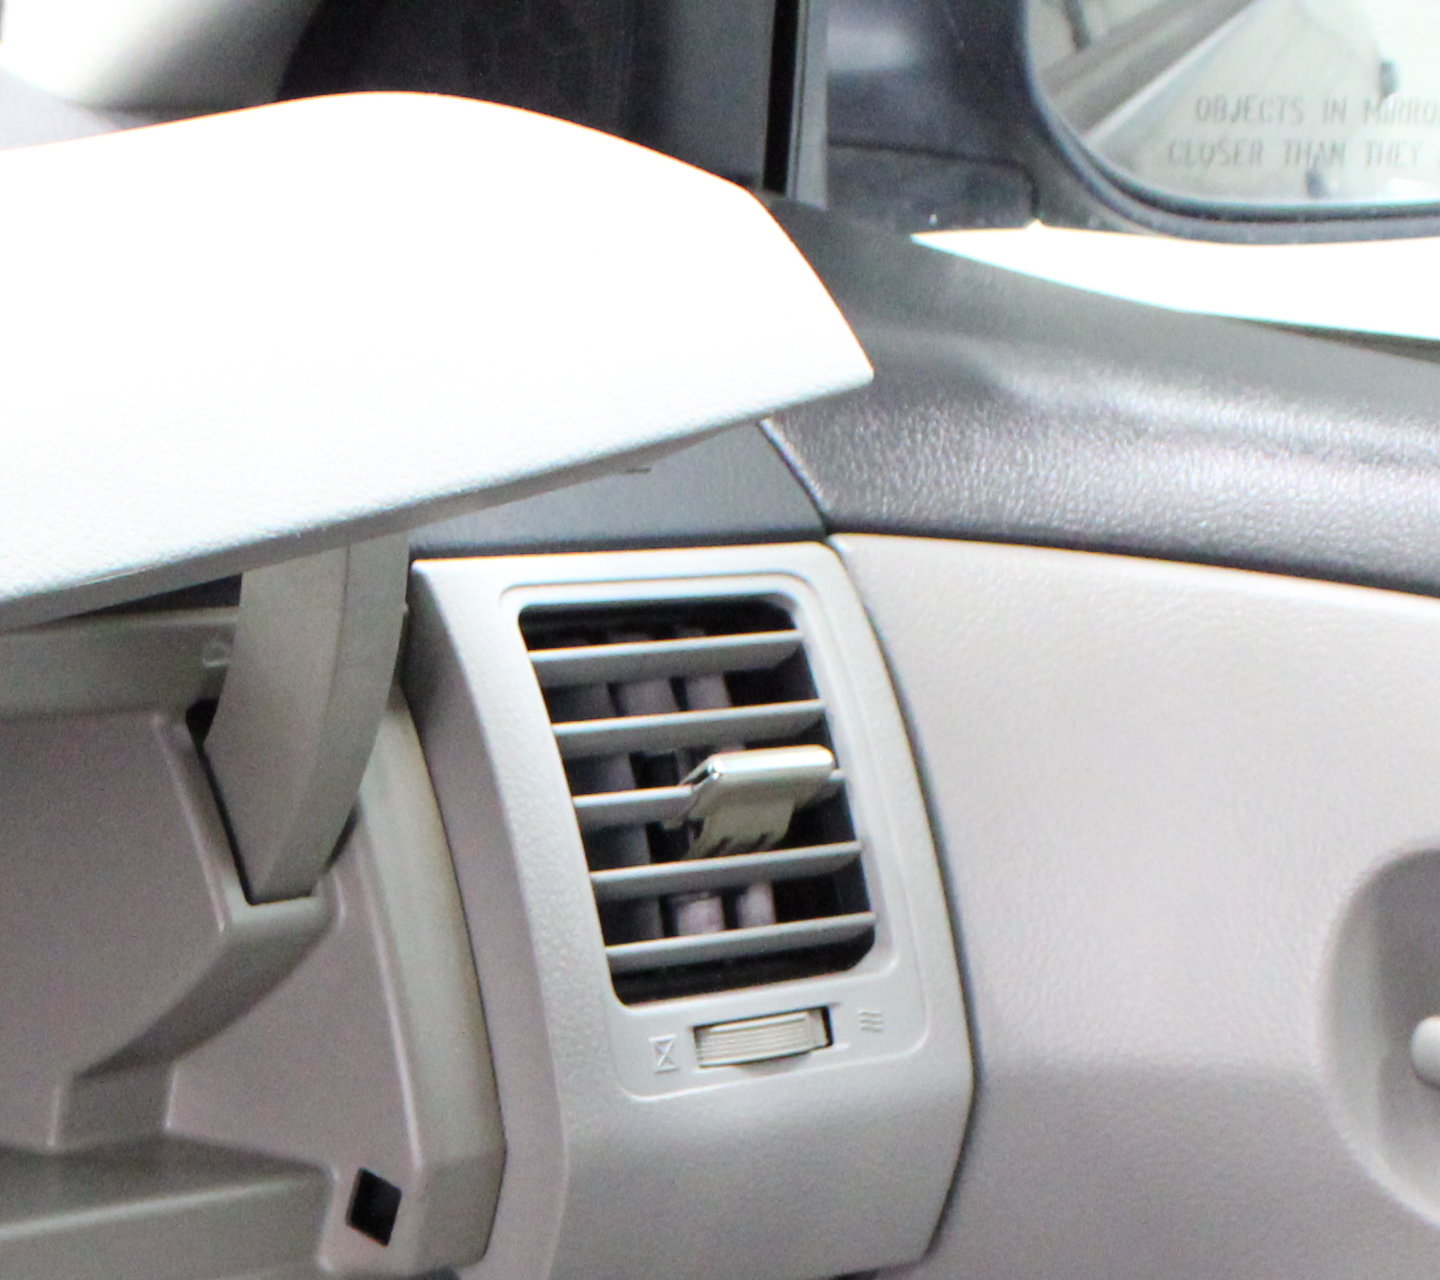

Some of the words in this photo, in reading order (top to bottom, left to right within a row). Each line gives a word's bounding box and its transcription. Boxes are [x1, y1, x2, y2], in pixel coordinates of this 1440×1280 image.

[1194, 97, 1305, 124] OBJECTS
[1323, 98, 1348, 124] IN
[1167, 140, 1265, 167] CLOSER
[1283, 140, 1347, 167] THAN
[1365, 140, 1421, 167] THEY
